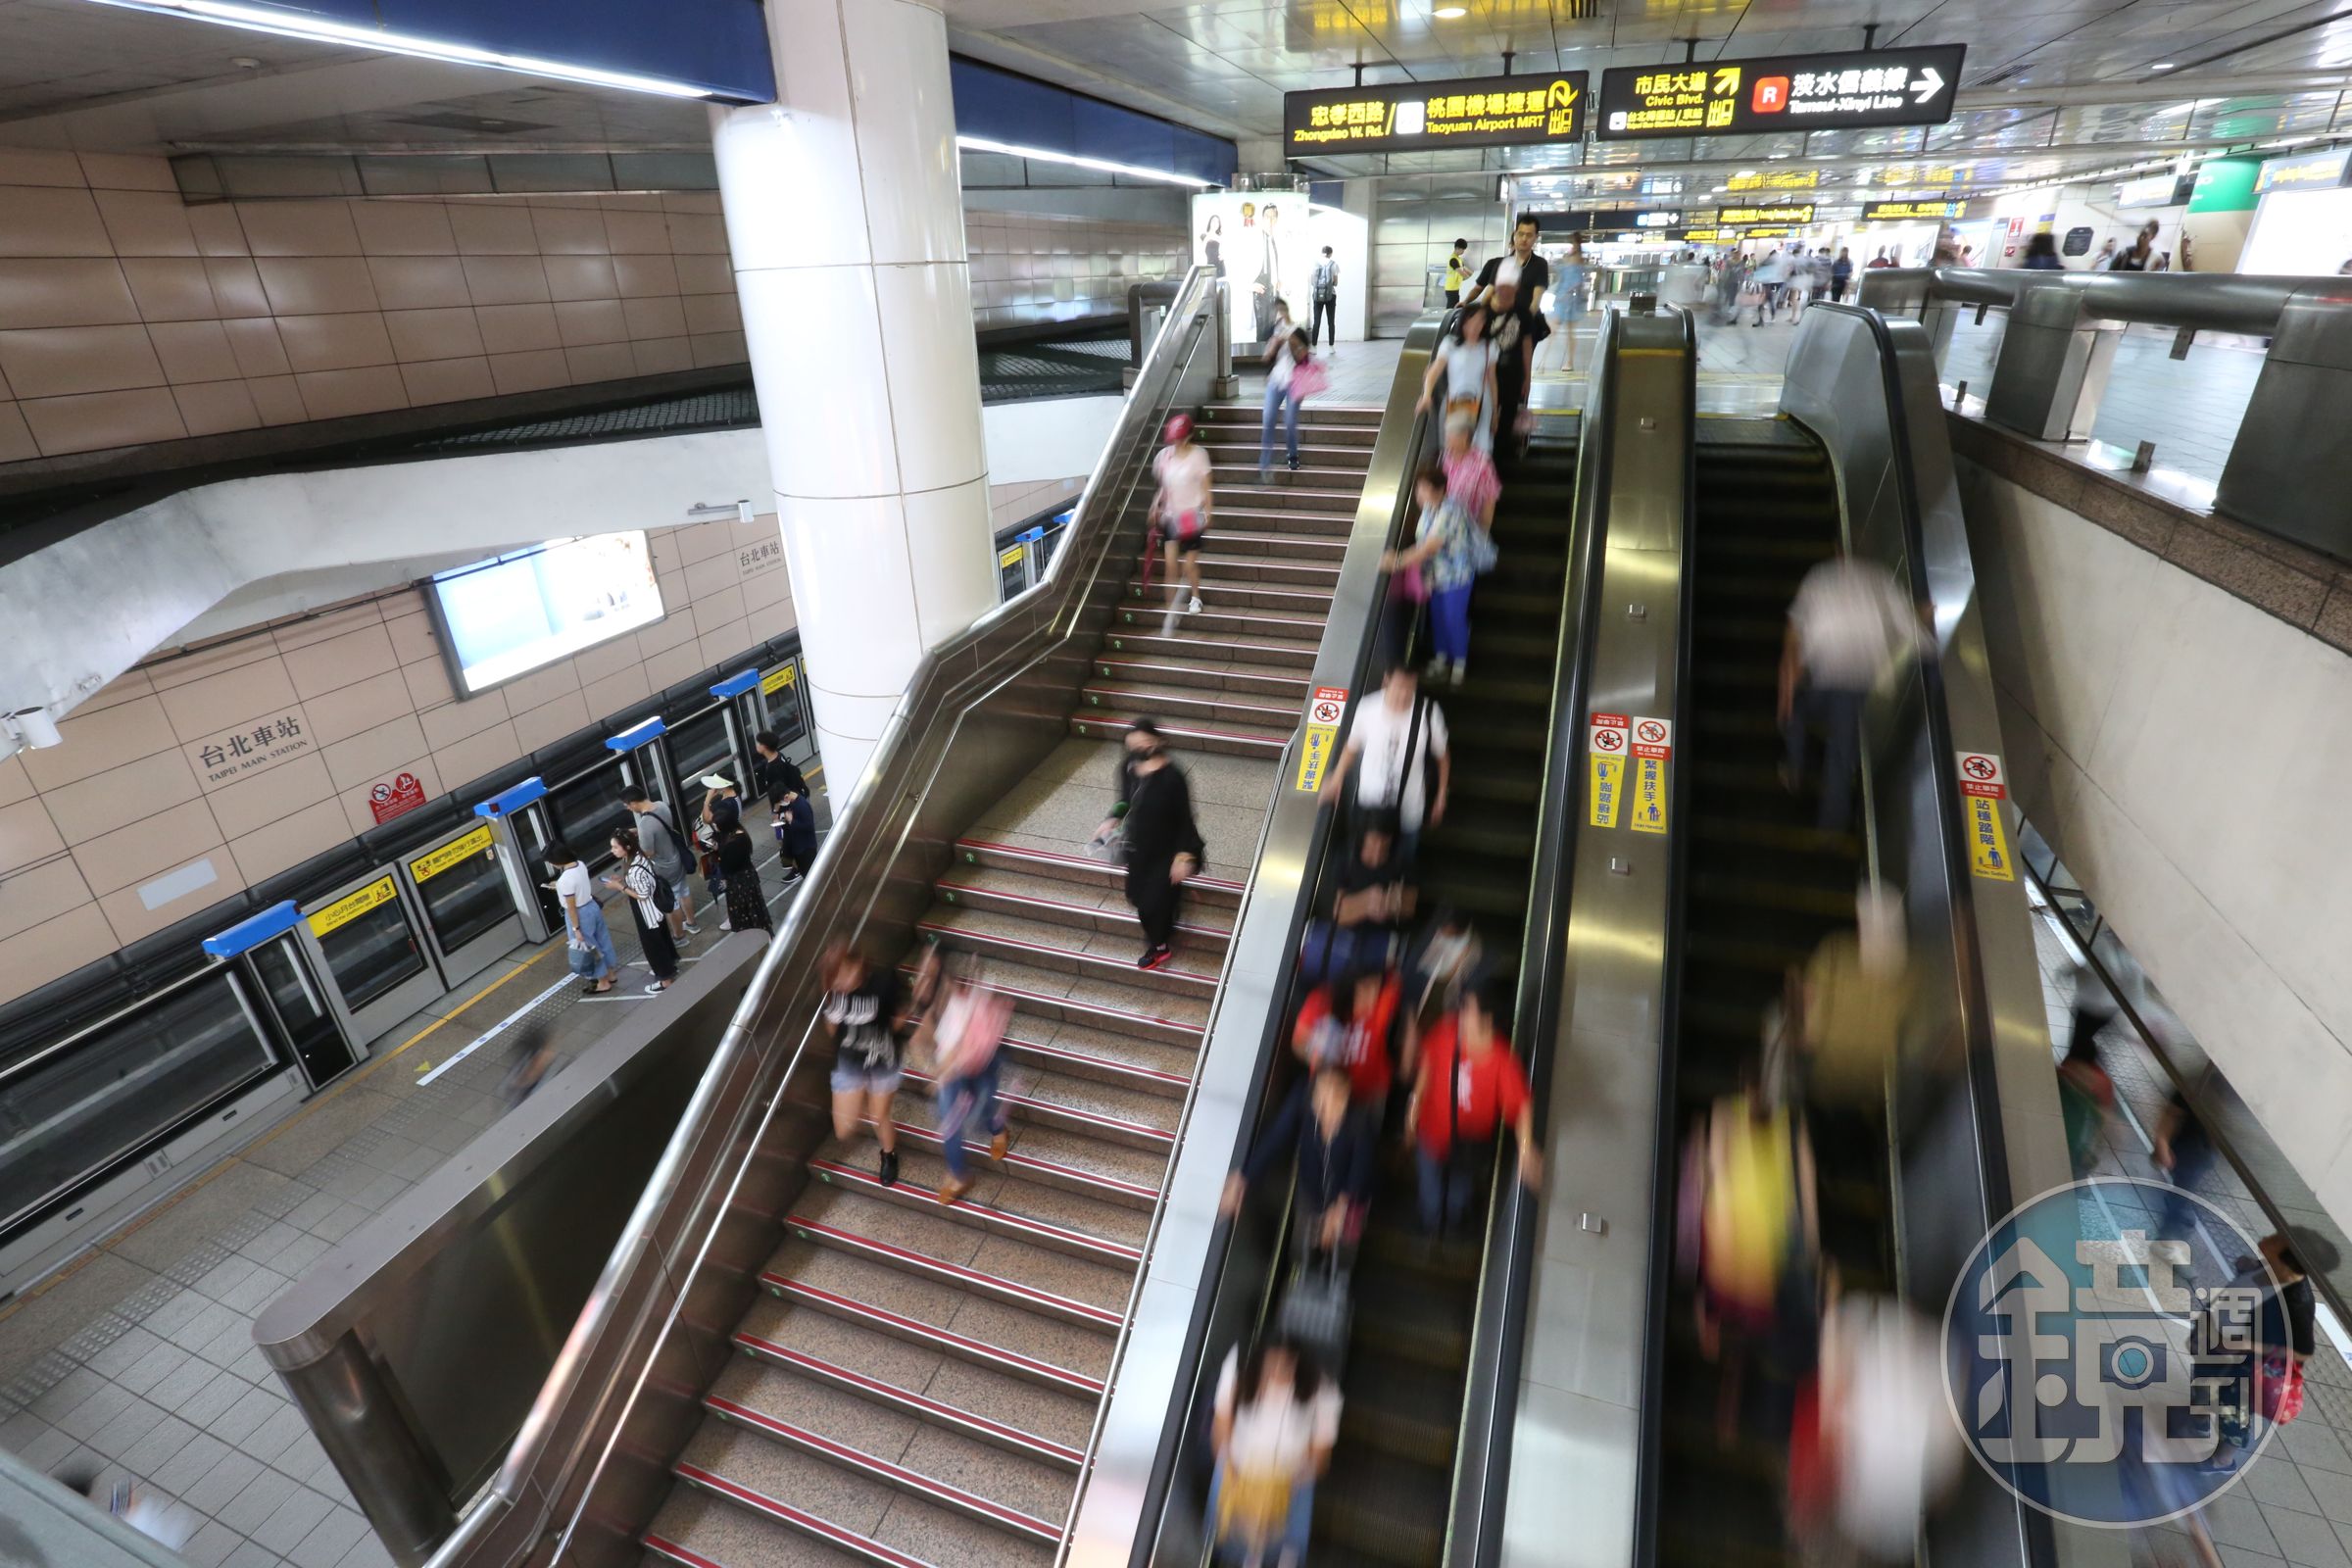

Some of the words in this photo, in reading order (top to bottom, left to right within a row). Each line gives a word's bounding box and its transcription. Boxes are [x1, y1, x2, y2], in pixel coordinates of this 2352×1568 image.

[1635, 72, 1707, 94] 市民大道
[1762, 86, 1778, 103] R
[1310, 101, 1385, 126] 忠孝西路
[1427, 90, 1547, 119] 桃園機場捷運
[1645, 95, 1674, 107] Civic
[1676, 93, 1705, 106] Blvd.
[1705, 98, 1735, 127] 出口
[1350, 125, 1363, 138] W.
[1365, 124, 1384, 137] Rd.
[1426, 121, 1472, 135] Taoyuan
[1474, 118, 1514, 132] Airport
[1517, 115, 1545, 128] MRT
[1547, 108, 1574, 135] 出口
[740, 541, 780, 567] 台北車站
[199, 716, 301, 768] 台北車站
[208, 766, 238, 782] TAIPEI
[240, 754, 268, 770] MAIN
[270, 739, 309, 759] STATION
[1644, 760, 1657, 802] 緊握扶手
[1976, 799, 1995, 846] 站穩踏階
